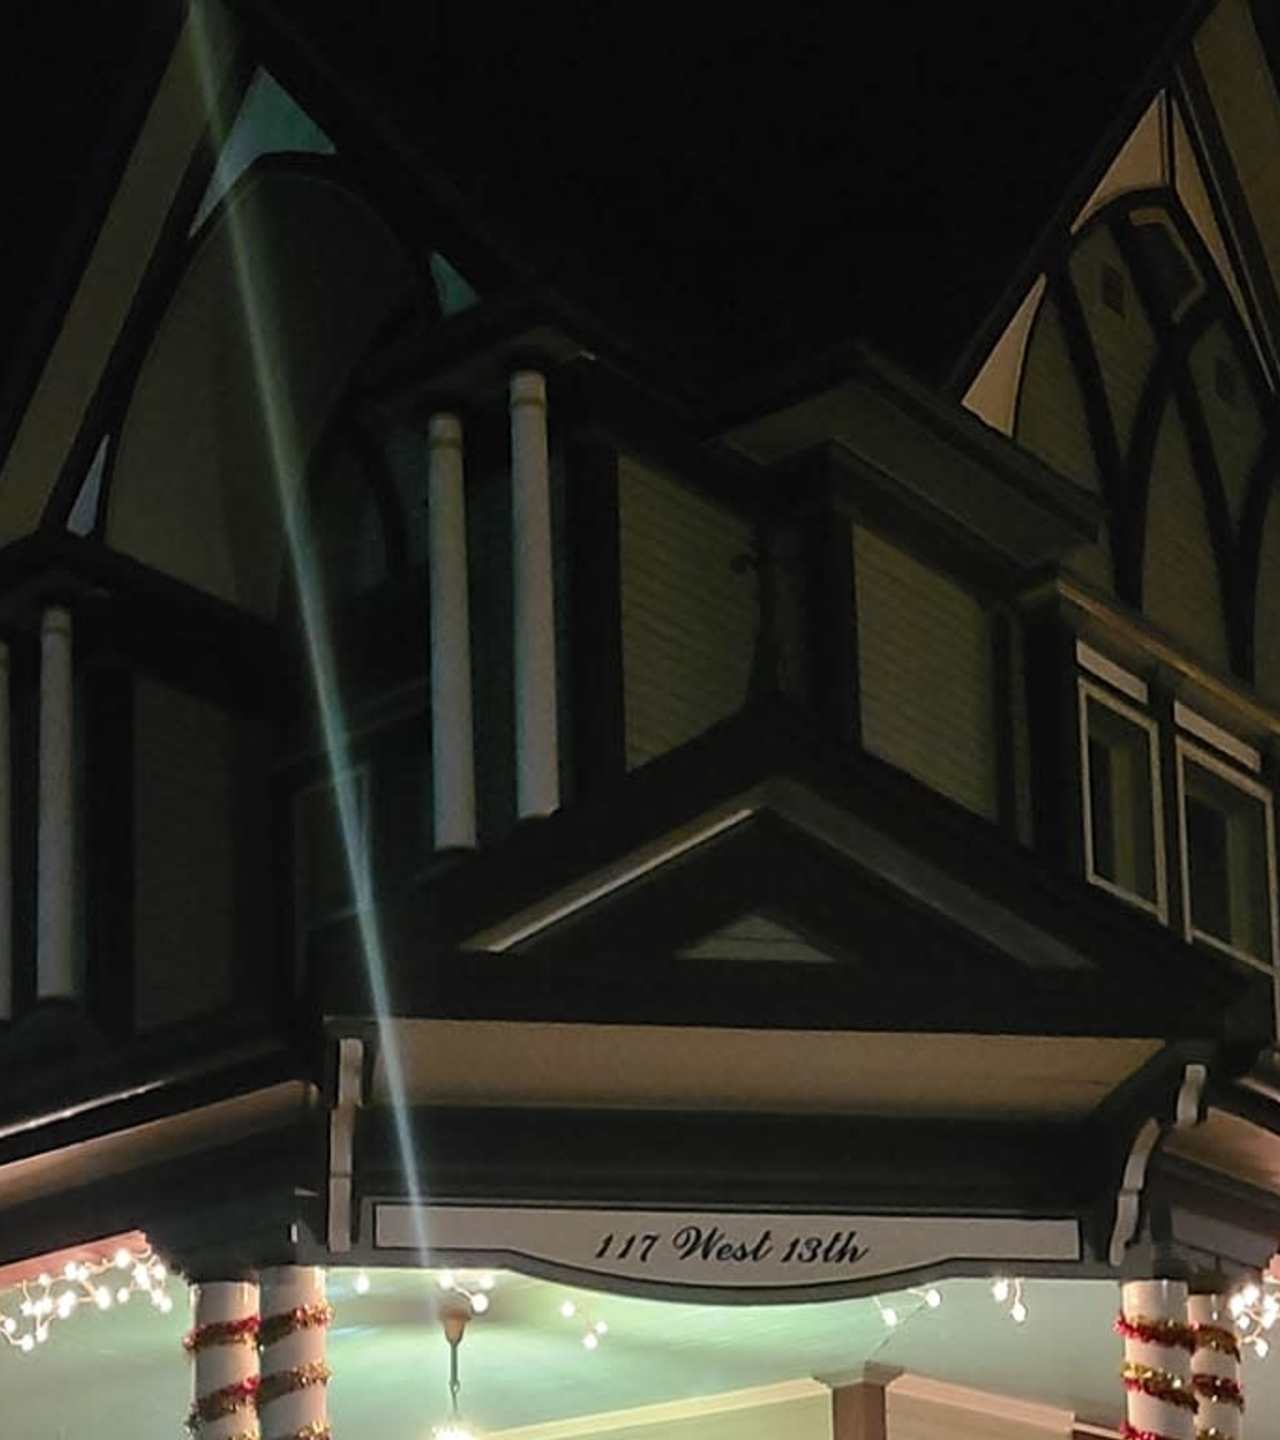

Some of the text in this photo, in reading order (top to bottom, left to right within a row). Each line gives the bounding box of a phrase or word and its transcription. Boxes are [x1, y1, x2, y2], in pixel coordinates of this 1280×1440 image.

[594, 1225, 870, 1264] 117 West 13th
